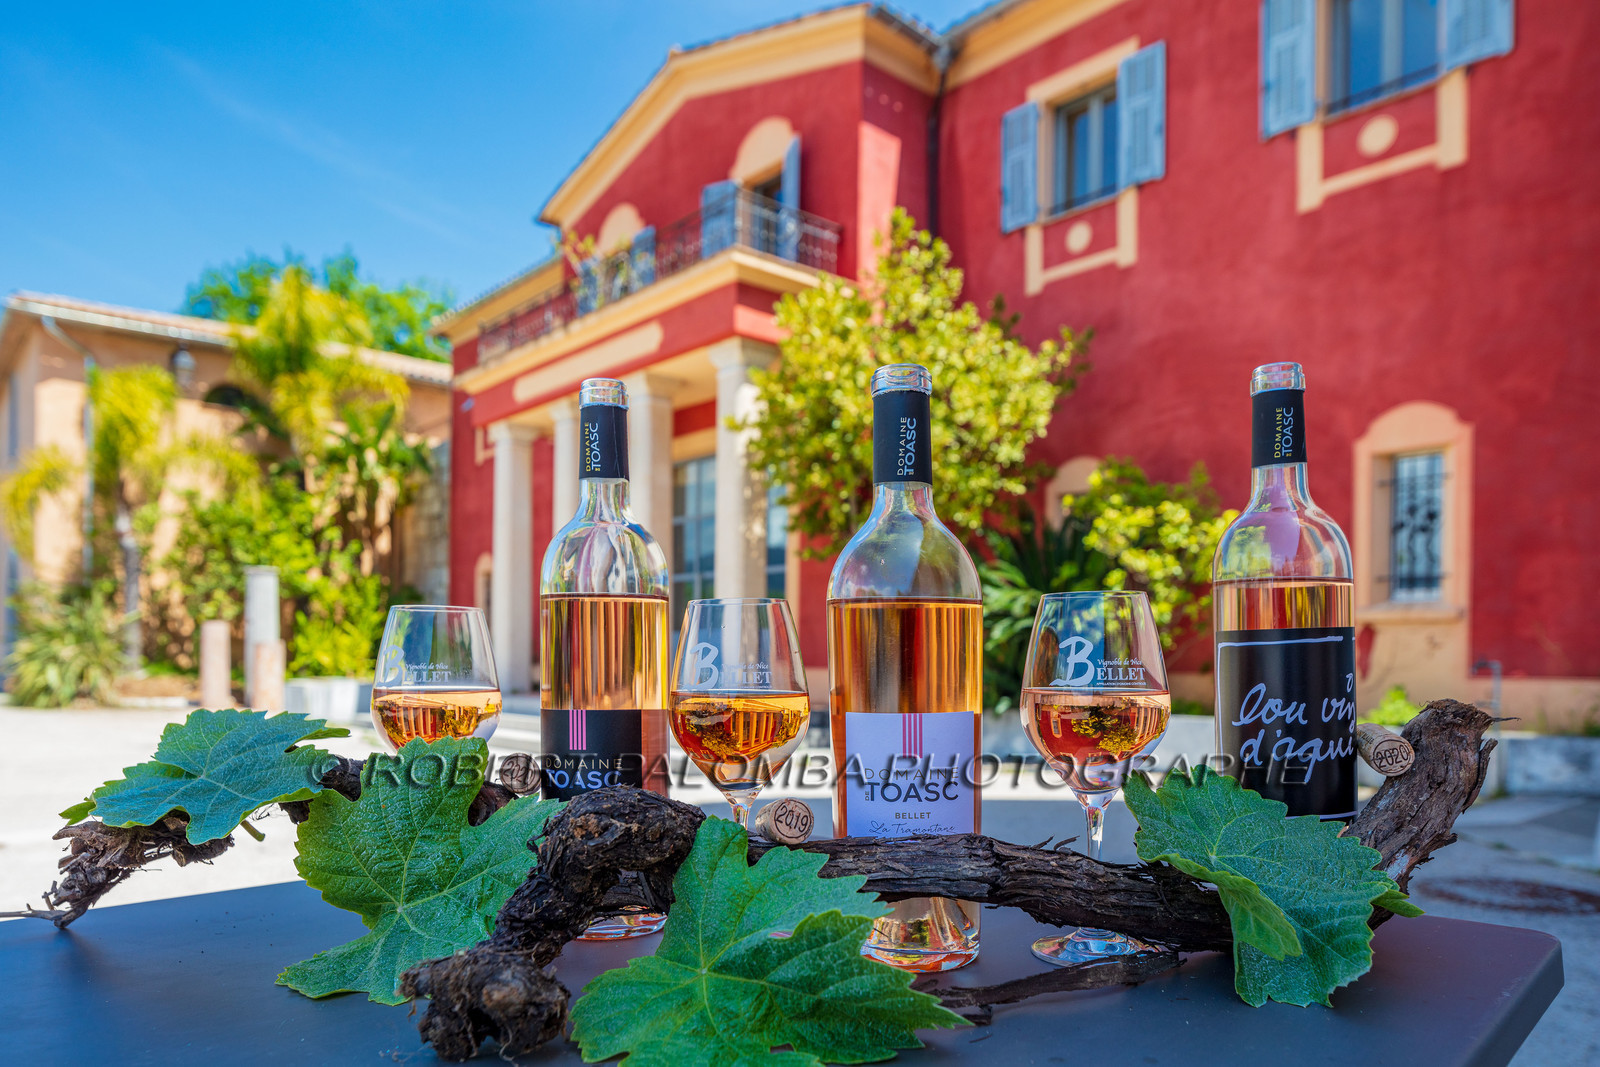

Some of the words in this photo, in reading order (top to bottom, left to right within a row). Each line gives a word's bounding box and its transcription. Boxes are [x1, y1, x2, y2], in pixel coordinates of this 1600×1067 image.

[590, 423, 601, 470] TOASC
[897, 416, 907, 476] DOMAINE
[903, 417, 917, 476] TOASC
[1274, 408, 1283, 458] DOMAINE
[1282, 408, 1293, 456] TOASC
[376, 645, 451, 687] BELLET
[1049, 636, 1146, 686] BELLET
[1097, 658, 1122, 667] Vignoble
[1231, 682, 1308, 725] lou
[545, 758, 623, 769] DOMAINE
[1239, 728, 1354, 784] d'aqui
[1376, 744, 1410, 768] 2020
[545, 769, 622, 789] TOASC
[864, 767, 959, 781] DOMAINE
[867, 781, 959, 802] TOASC
[865, 790, 870, 801] DE
[775, 804, 809, 833] 2019
[869, 820, 891, 834] La
[891, 823, 957, 835] Tramontane
